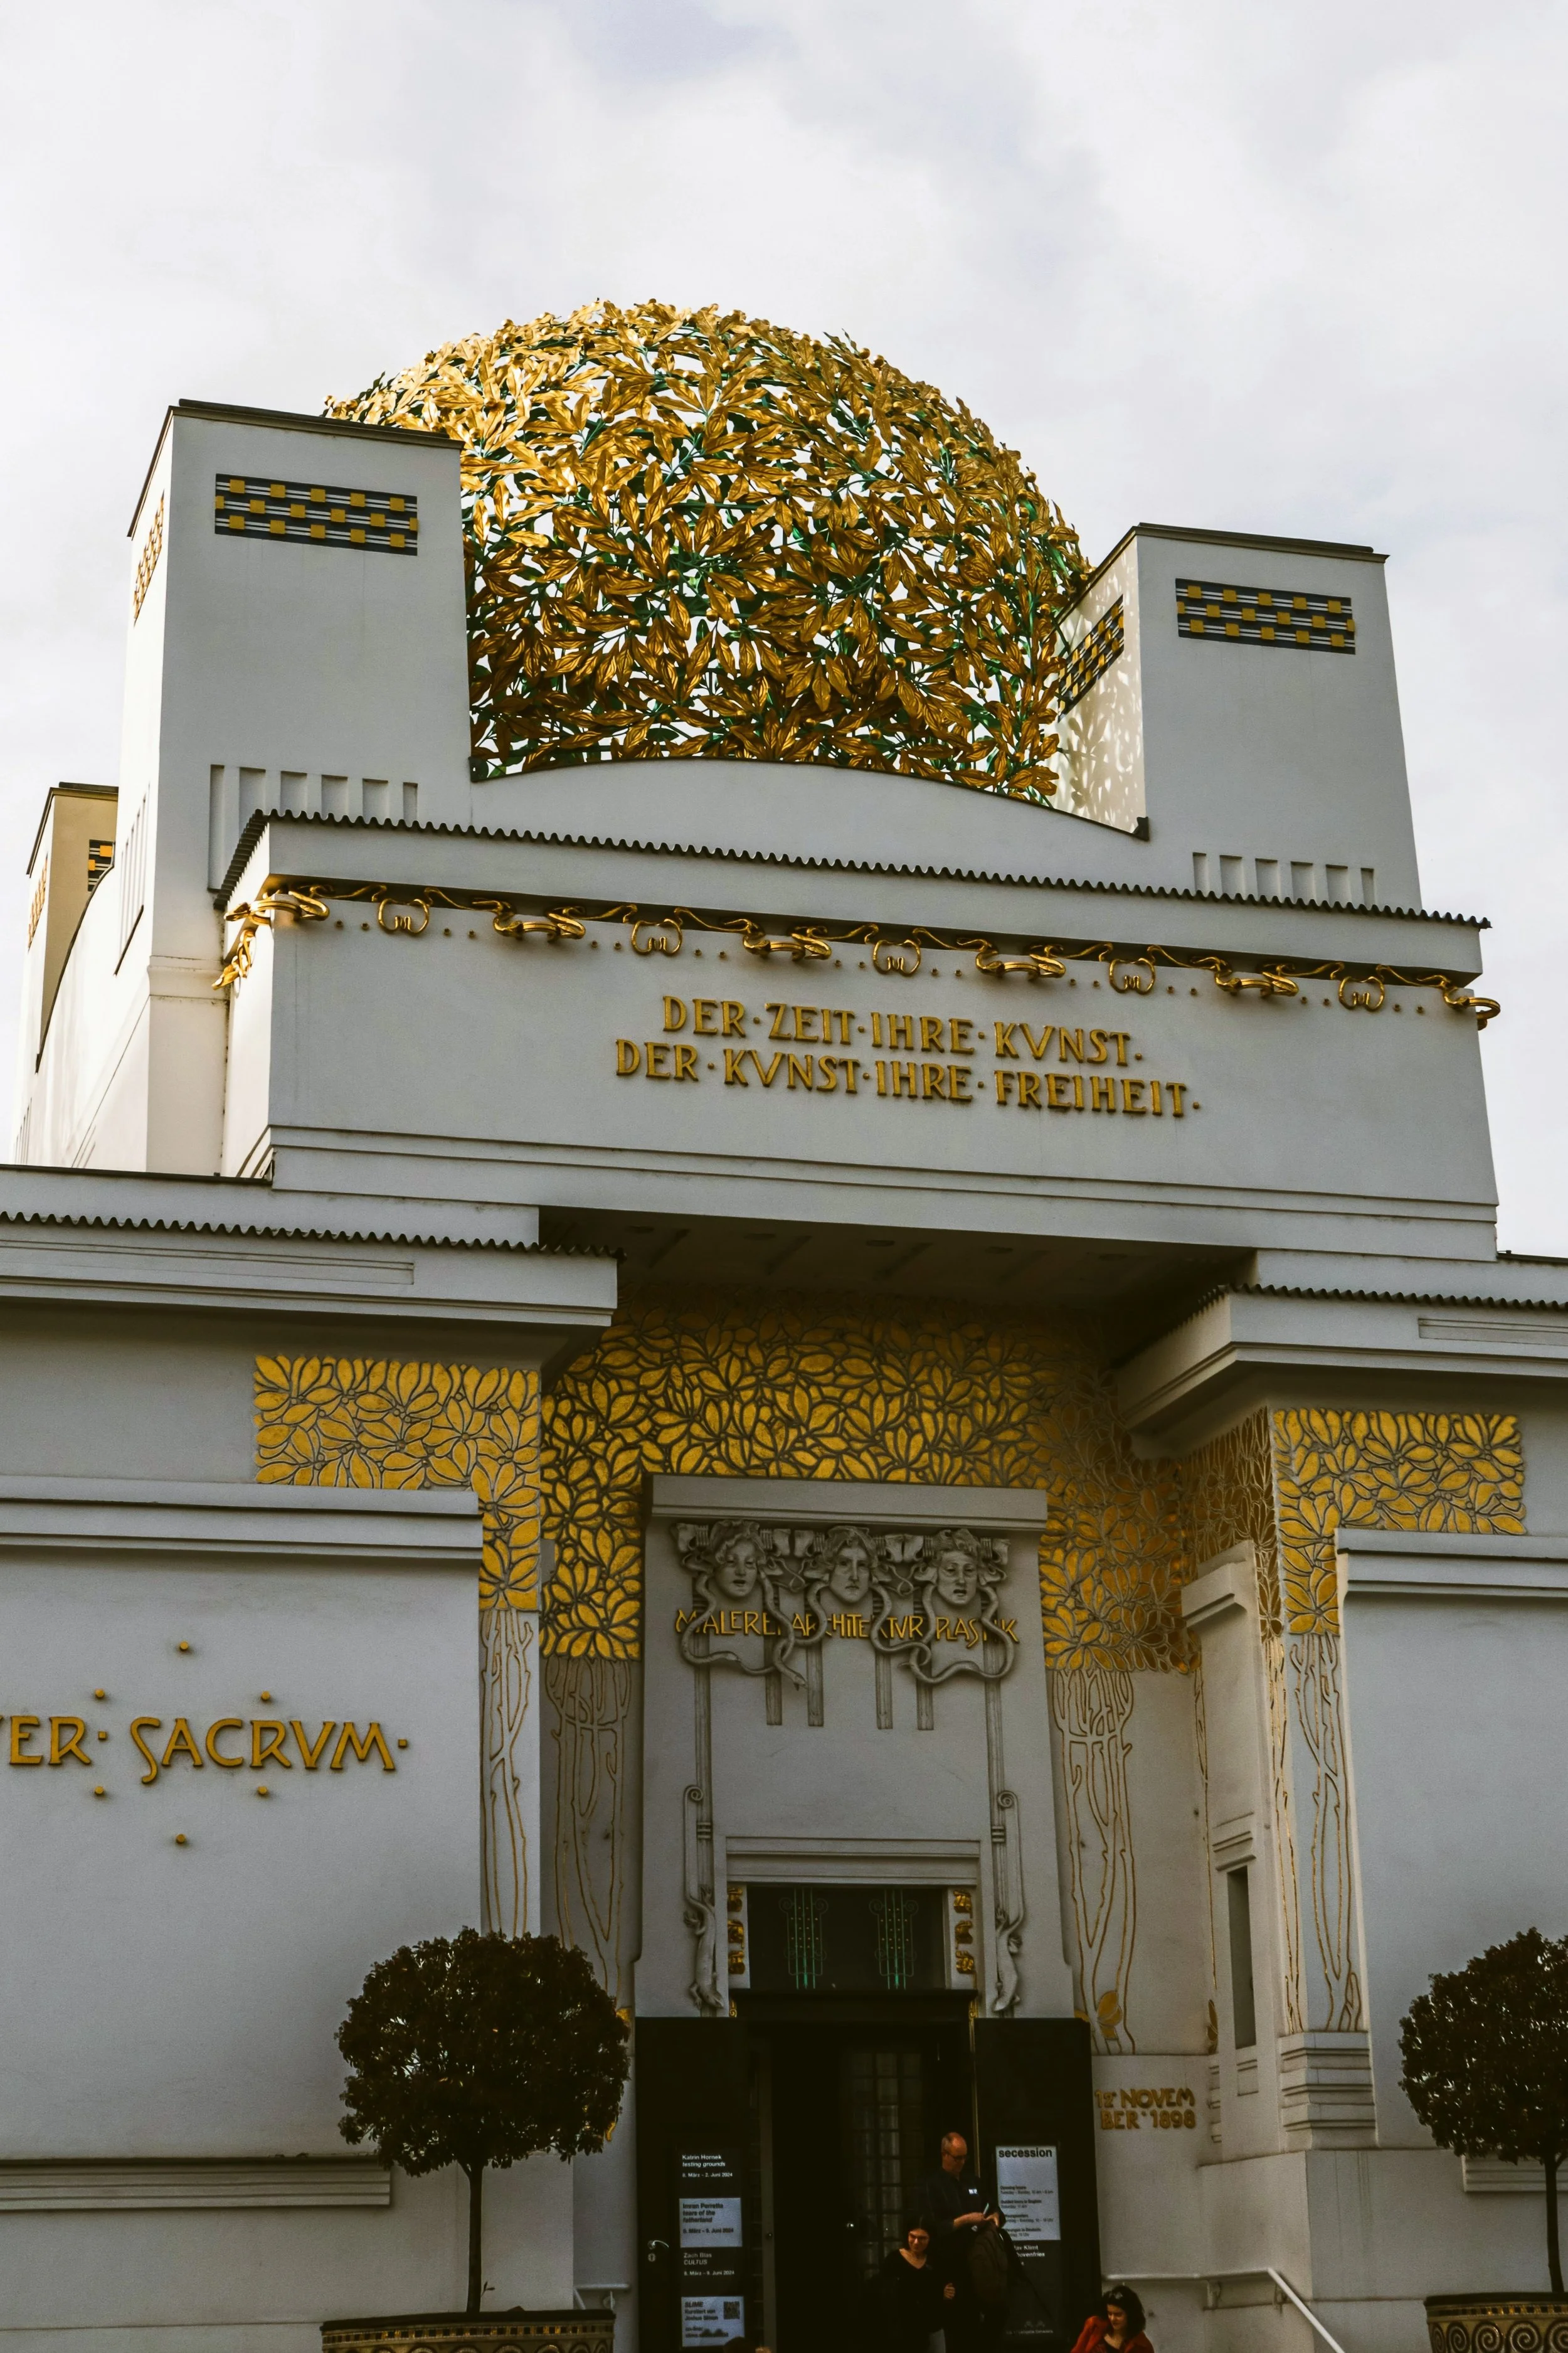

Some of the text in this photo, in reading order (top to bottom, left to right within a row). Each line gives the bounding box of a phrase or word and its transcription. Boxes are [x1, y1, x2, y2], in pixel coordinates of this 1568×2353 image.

[662, 995, 746, 1038] DER
[765, 1002, 855, 1045] ZEIT
[871, 1011, 975, 1055] IHRE
[616, 1039, 699, 1081] DER
[723, 1048, 860, 1094] KVNST
[876, 1060, 973, 1102] IHRE
[936, 1616, 1019, 1649] PLASK
[0, 1715, 396, 1784] ER SACRVM
[1120, 2088, 1195, 2108] NOVEM
[1101, 2109, 1197, 2130] BER 1898
[999, 2147, 1052, 2158] secession
